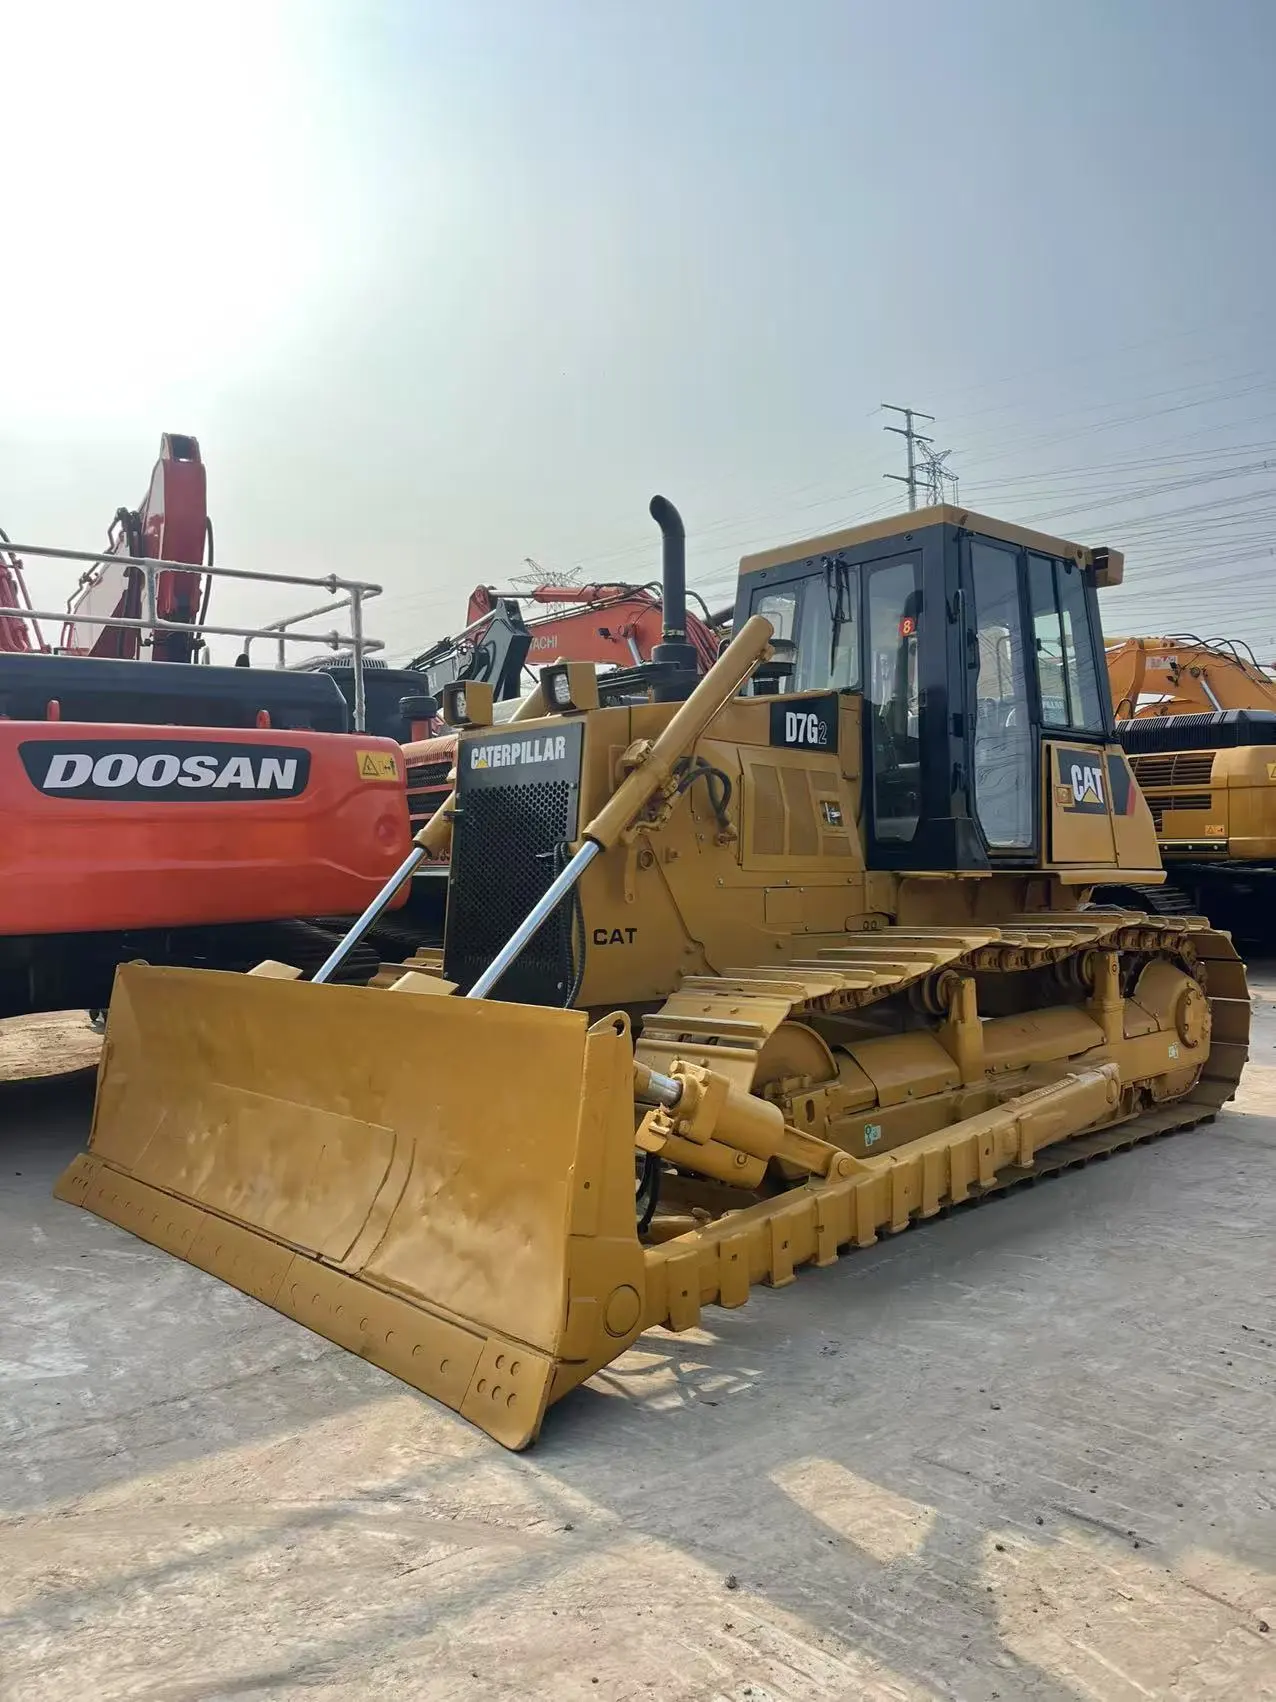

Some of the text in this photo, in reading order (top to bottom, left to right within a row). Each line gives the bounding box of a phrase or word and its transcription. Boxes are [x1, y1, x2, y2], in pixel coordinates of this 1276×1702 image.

[470, 735, 566, 770] CATERPILLAR
[43, 753, 298, 790] DOOSAN
[1070, 764, 1104, 804] CAT
[593, 927, 638, 946] CAT
